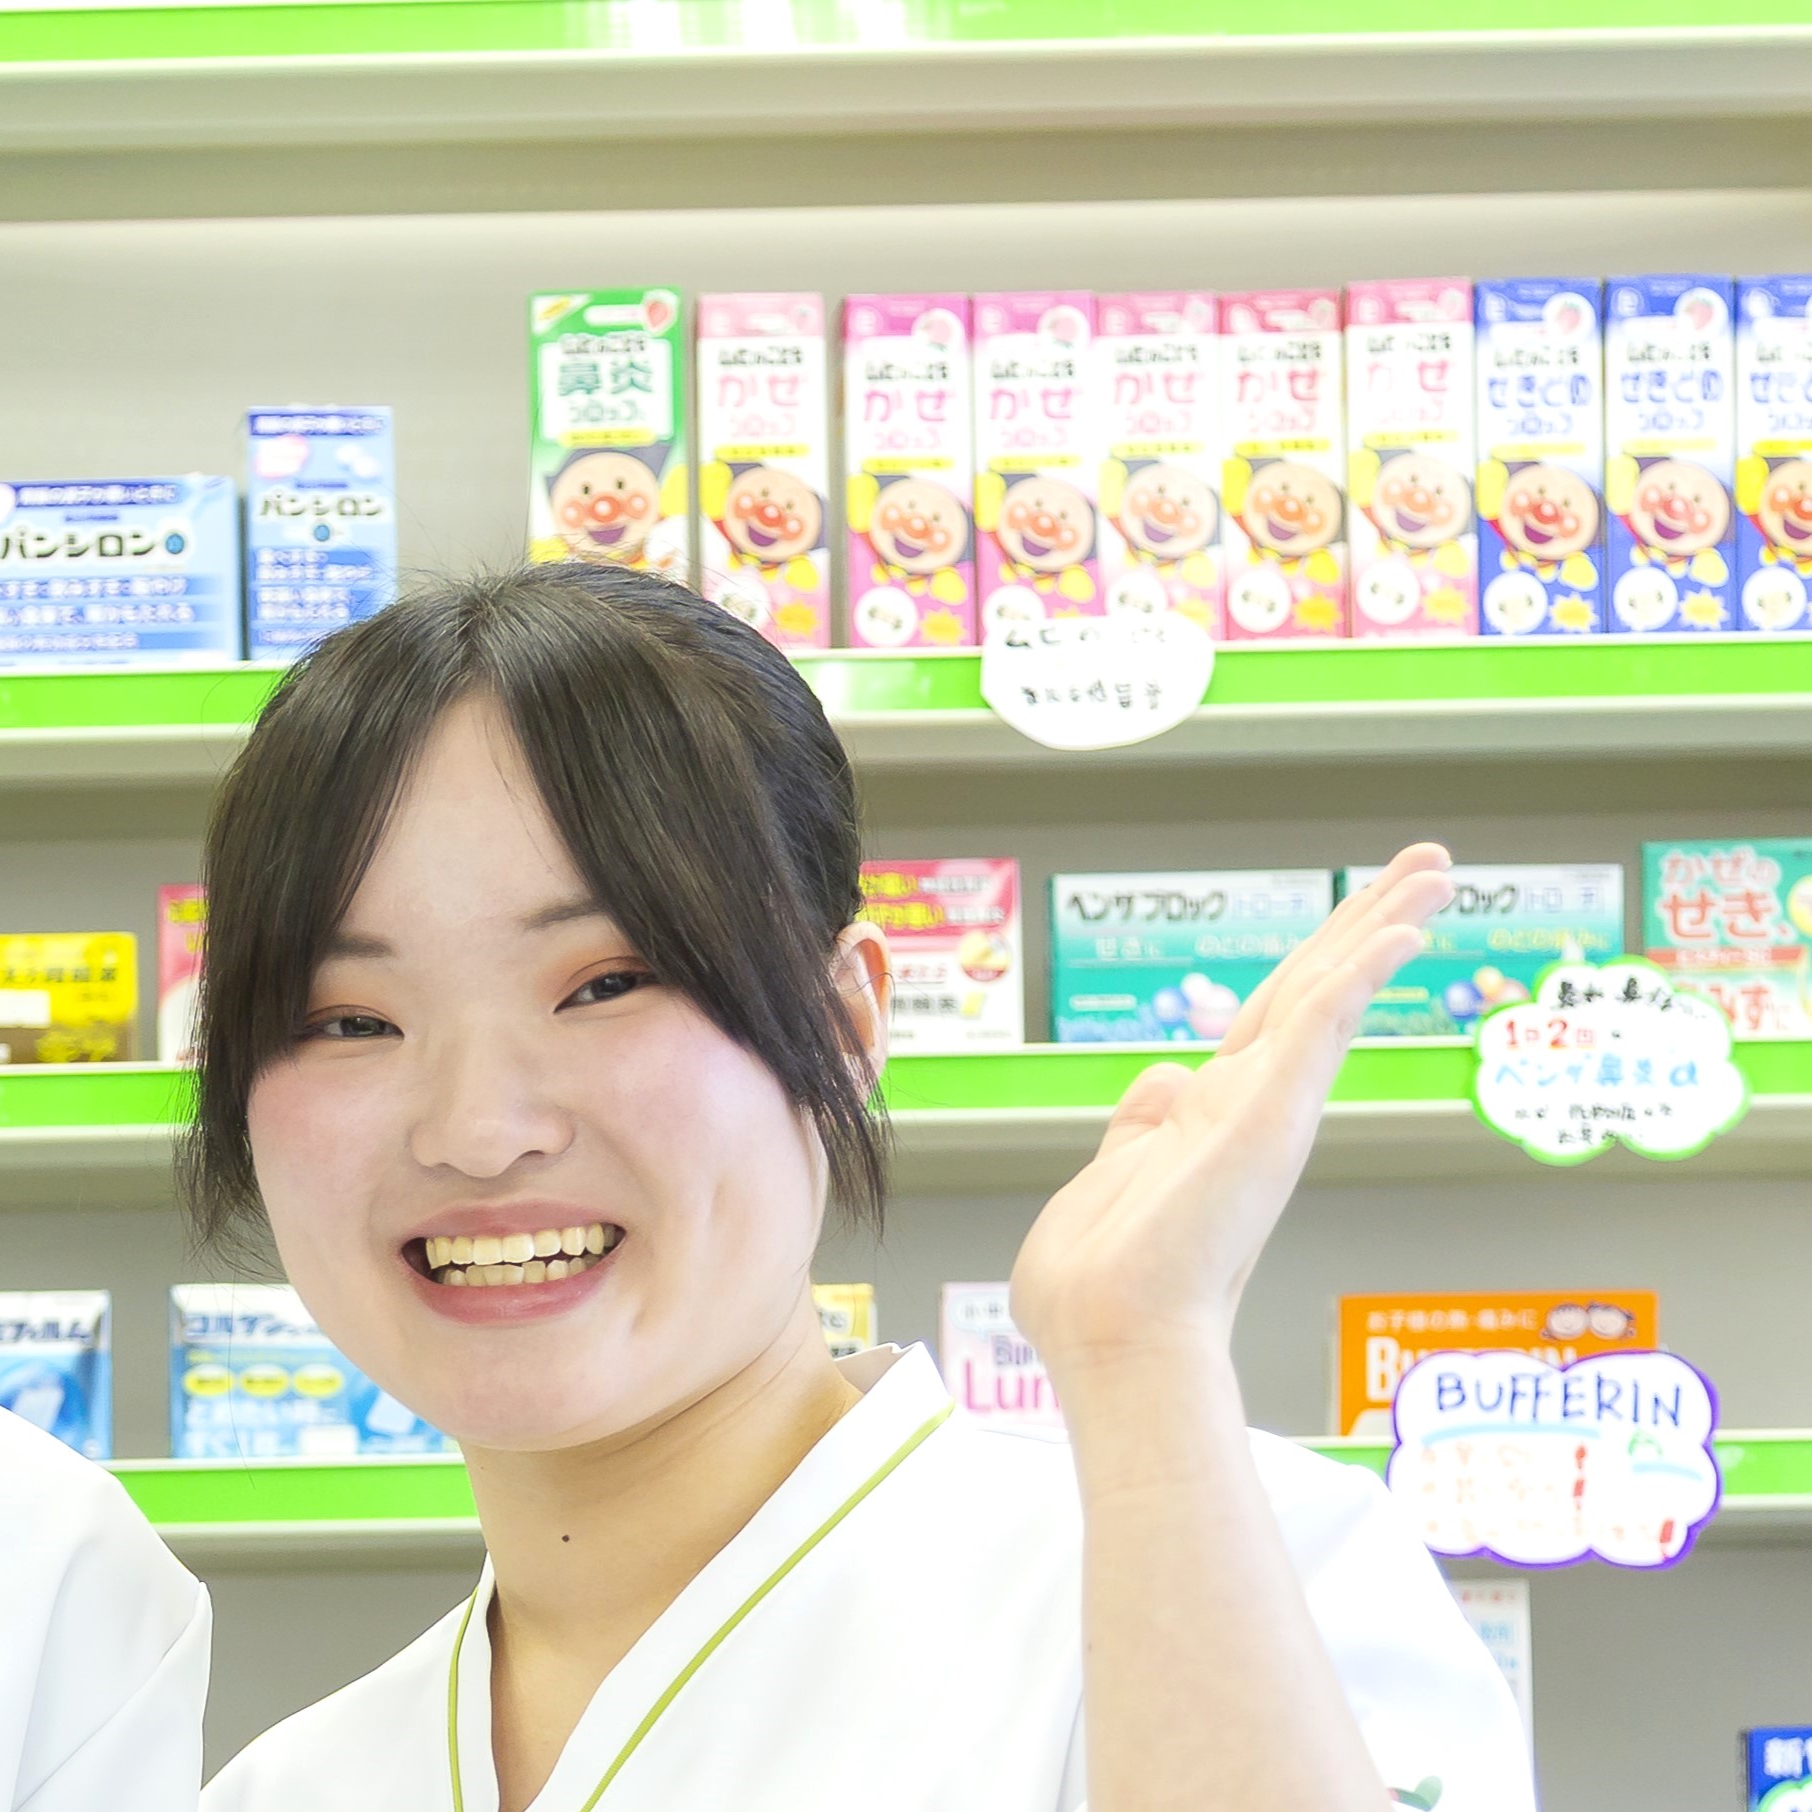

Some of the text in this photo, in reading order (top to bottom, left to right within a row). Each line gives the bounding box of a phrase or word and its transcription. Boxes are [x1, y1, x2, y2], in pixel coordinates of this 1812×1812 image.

[558, 361, 654, 397] 鼻炎
[717, 373, 809, 408] かぜ
[1114, 371, 1203, 405] かぜ
[1237, 368, 1322, 402] かぜ
[863, 387, 956, 422] かぜ
[989, 387, 1081, 421] かぜ
[260, 489, 383, 517] パンシロン
[1662, 850, 1780, 884] かぜの
[1066, 888, 1229, 923] ベンザブロック
[1444, 883, 1518, 916] ロック
[1435, 1370, 1682, 1428] BUFFERIN
[1763, 1737, 1812, 1778] 新
